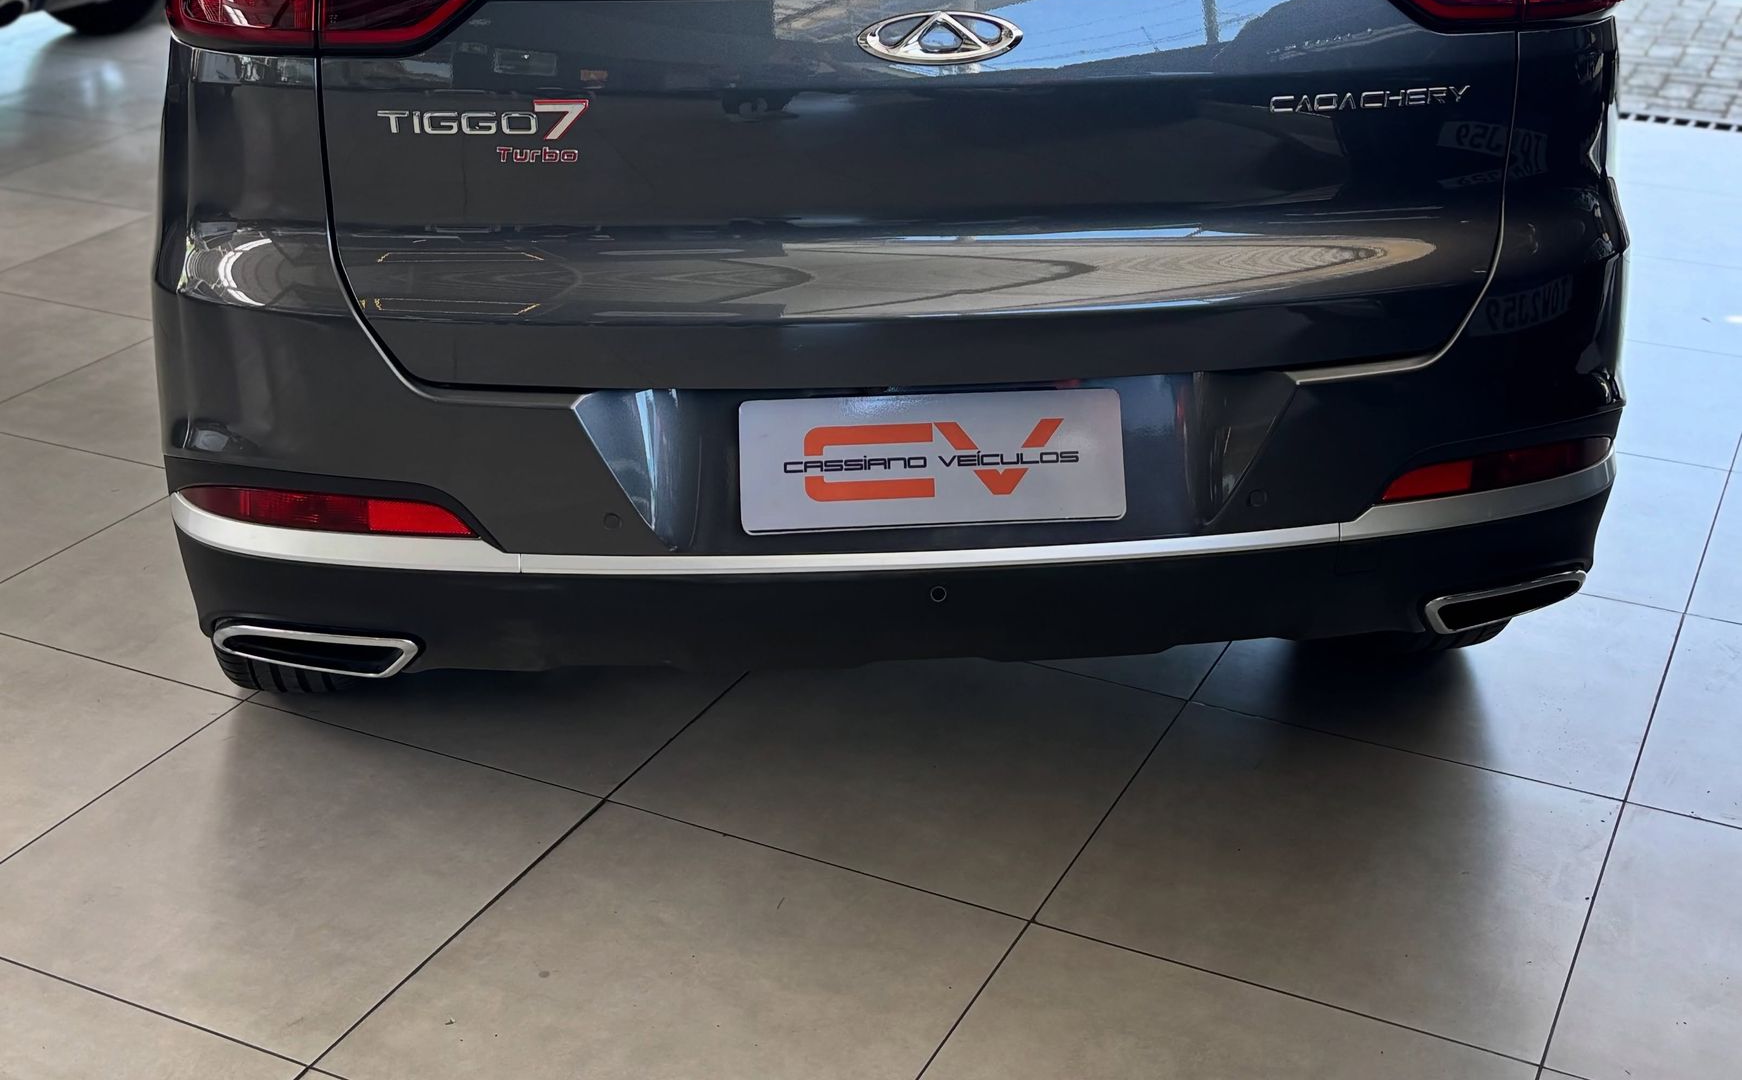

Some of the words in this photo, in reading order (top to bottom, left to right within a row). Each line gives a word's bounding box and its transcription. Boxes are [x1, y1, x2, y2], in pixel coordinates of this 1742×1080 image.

[496, 146, 579, 163] Turbo
[783, 454, 928, 475] CASSIANO
[937, 450, 1080, 469] VEÍCULOS
